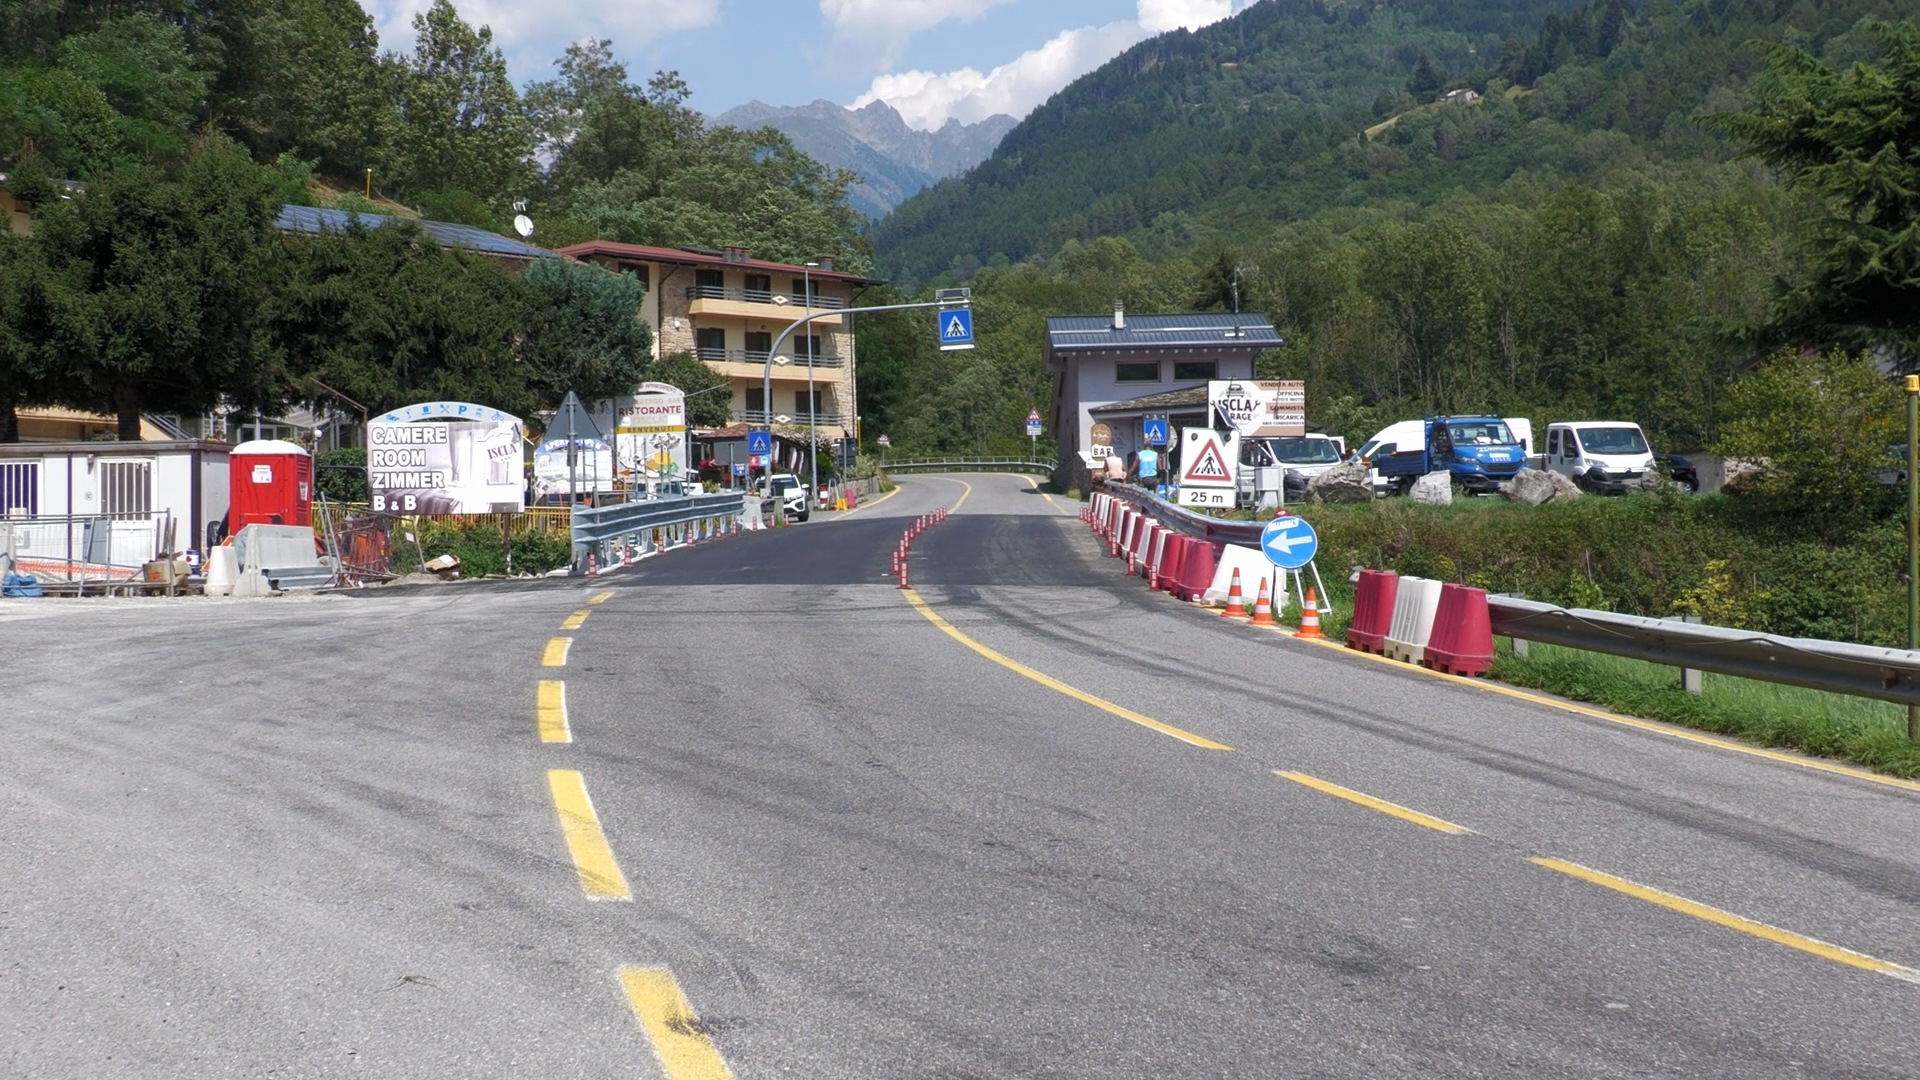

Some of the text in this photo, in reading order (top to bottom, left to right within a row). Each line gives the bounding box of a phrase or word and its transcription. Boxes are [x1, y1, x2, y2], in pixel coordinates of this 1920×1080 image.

[618, 405, 682, 416] RISTORANTE
[1230, 413, 1252, 421] RAGE
[371, 426, 448, 445] CAMERE
[372, 449, 426, 467] ROOM
[487, 443, 518, 460] ISCLA
[372, 471, 445, 489] ZIMMER
[373, 494, 417, 511] B & B
[1190, 491, 1223, 503] 25 m
